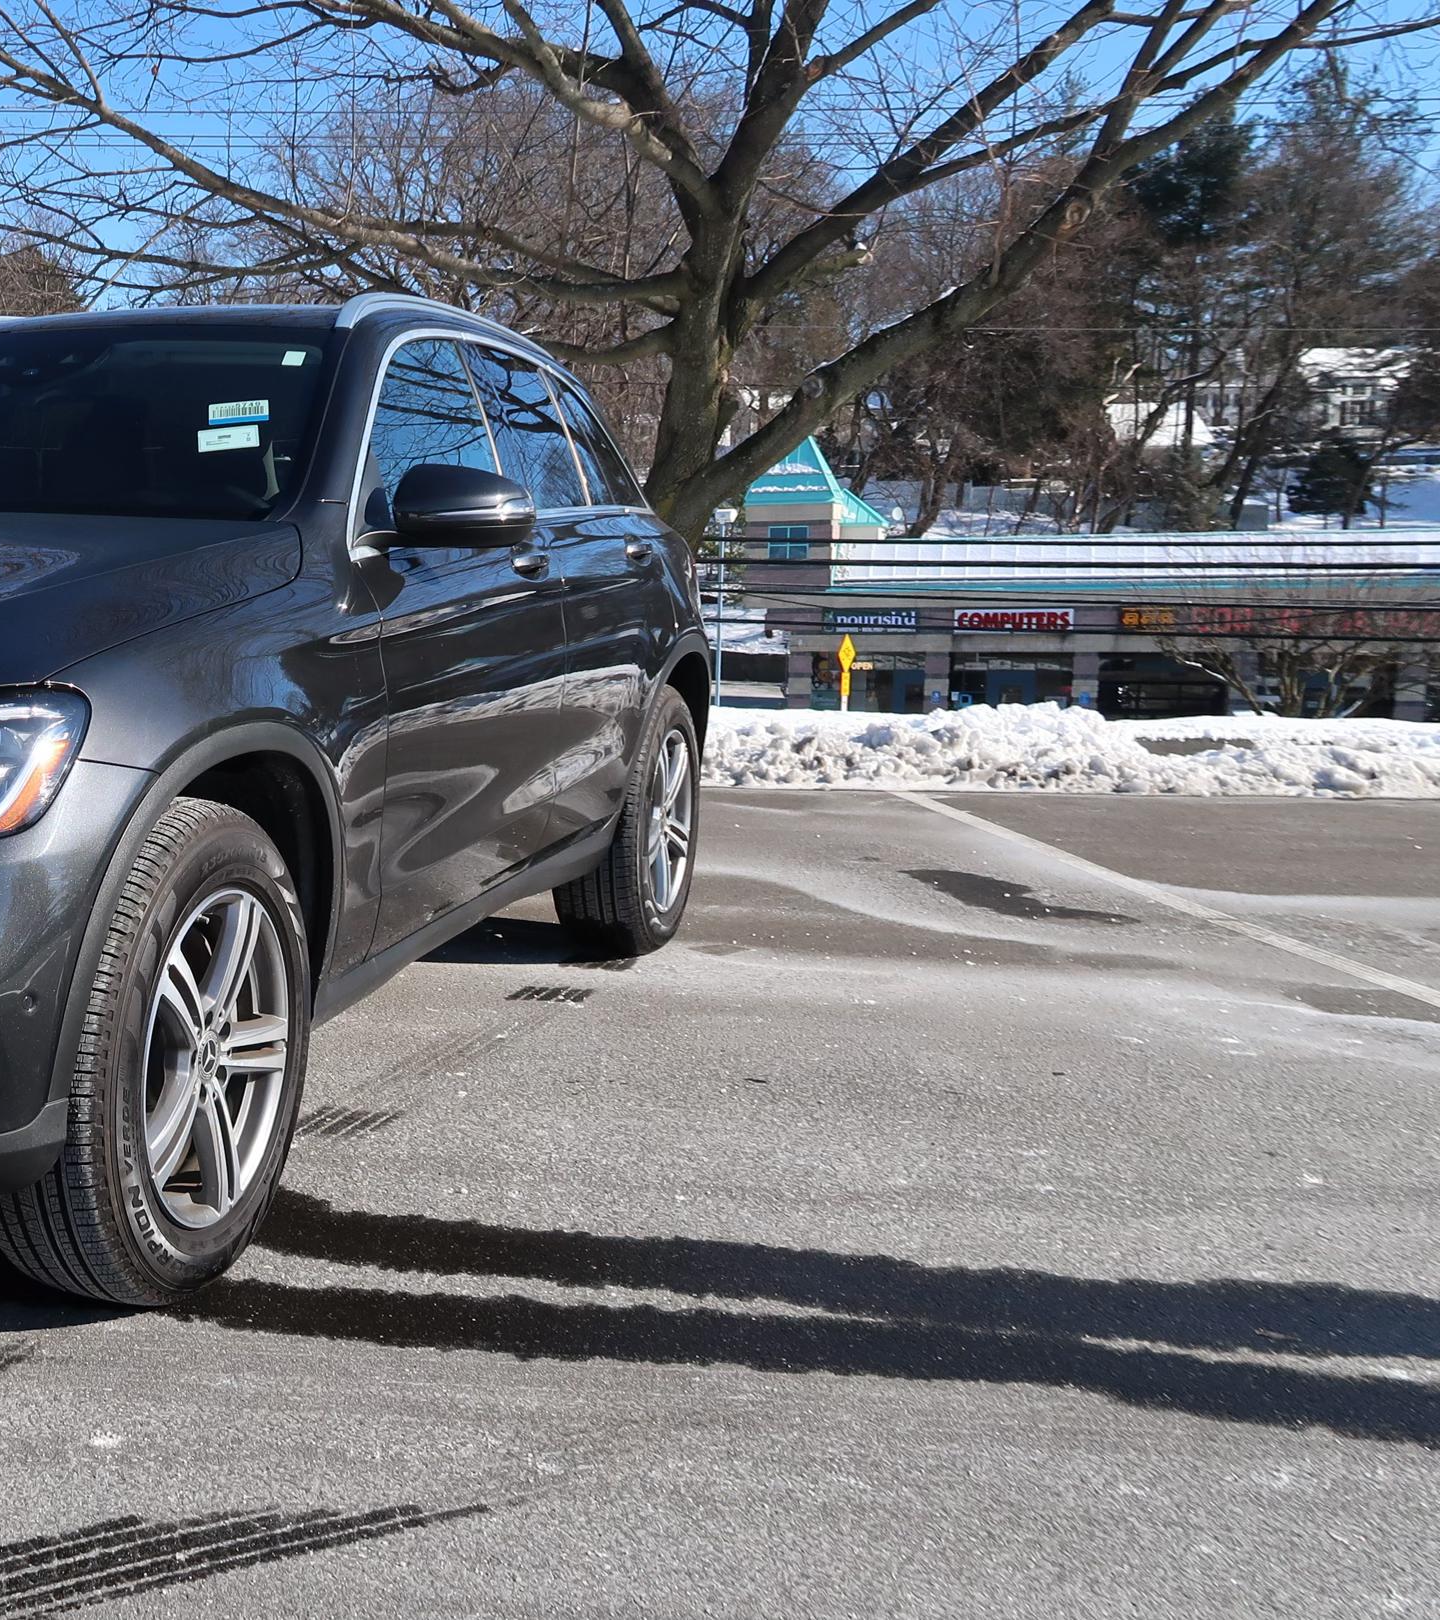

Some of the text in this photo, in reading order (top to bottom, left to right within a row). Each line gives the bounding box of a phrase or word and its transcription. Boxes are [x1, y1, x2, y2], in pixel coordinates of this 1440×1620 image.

[957, 612, 1070, 630] COMPUTERS
[851, 662, 873, 671] OPEN
[120, 1088, 135, 1176] VERDE
